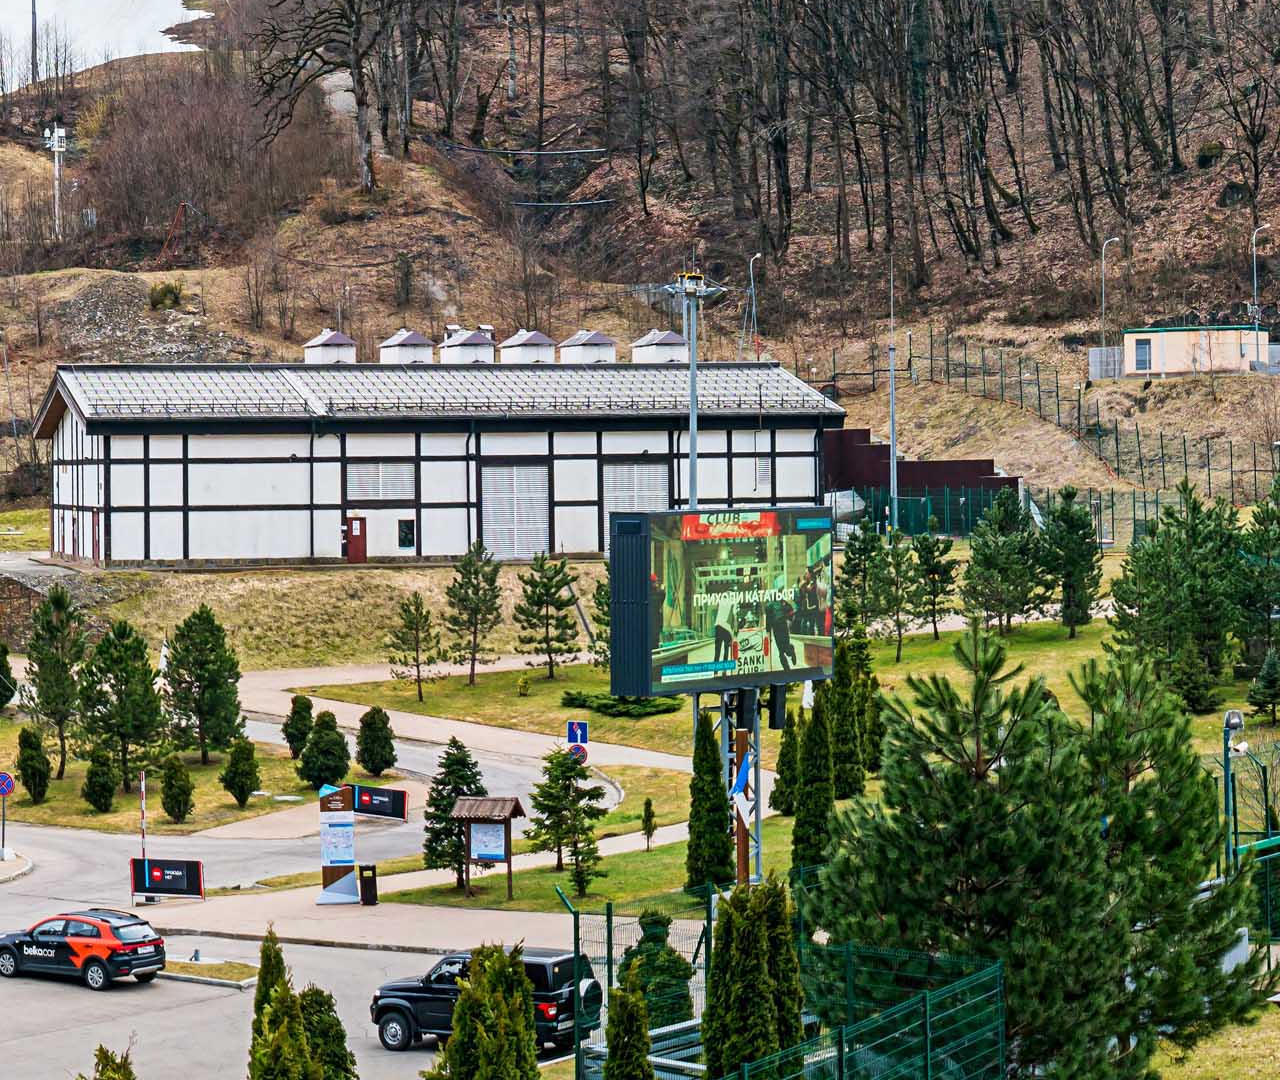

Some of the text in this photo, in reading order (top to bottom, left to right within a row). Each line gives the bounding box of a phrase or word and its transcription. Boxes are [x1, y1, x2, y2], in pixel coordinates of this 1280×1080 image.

[707, 513, 740, 525] CLUB
[693, 589, 795, 607] ПРИХОДИ КАТАТЬСЯ
[738, 655, 765, 668] SANKI
[24, 944, 55, 958] belkacar
